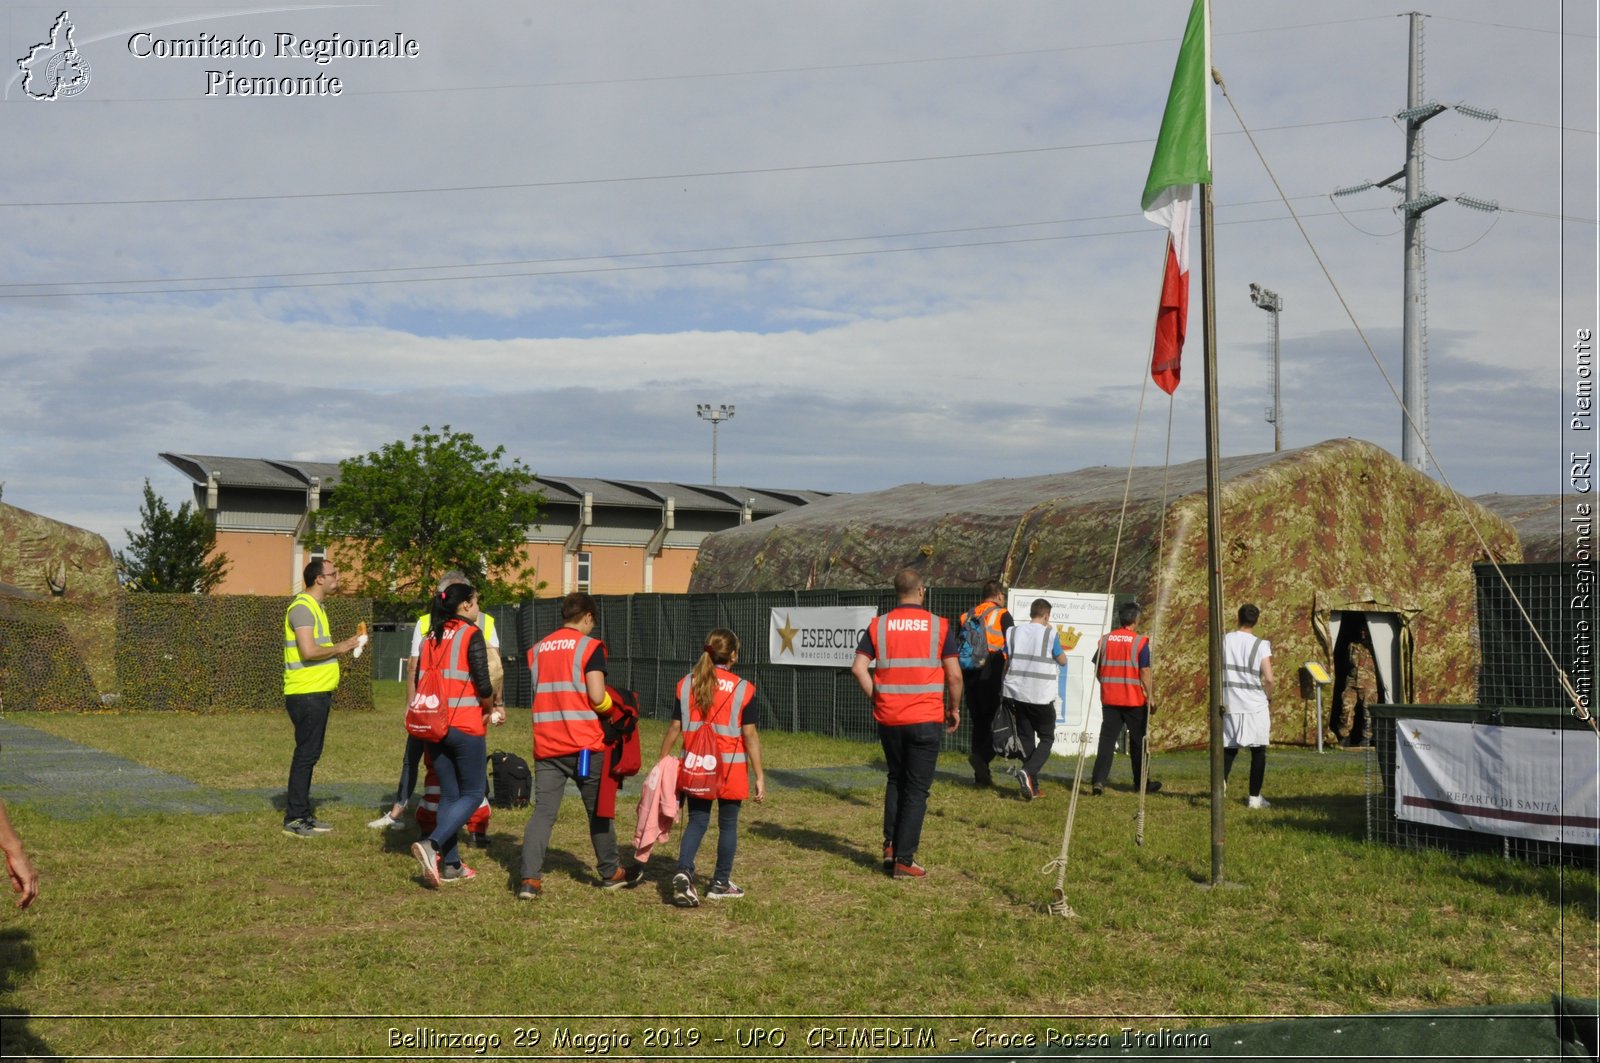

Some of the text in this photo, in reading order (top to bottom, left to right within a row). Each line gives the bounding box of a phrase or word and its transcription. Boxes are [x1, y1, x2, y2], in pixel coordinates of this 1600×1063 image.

[887, 619, 928, 631] NURSE
[1108, 634, 1133, 643] DOCTOR
[539, 639, 576, 653] DOCTOR
[1071, 732, 1094, 744] CURE
[1446, 791, 1498, 806] REPARTO
[1500, 799, 1513, 809] DI
